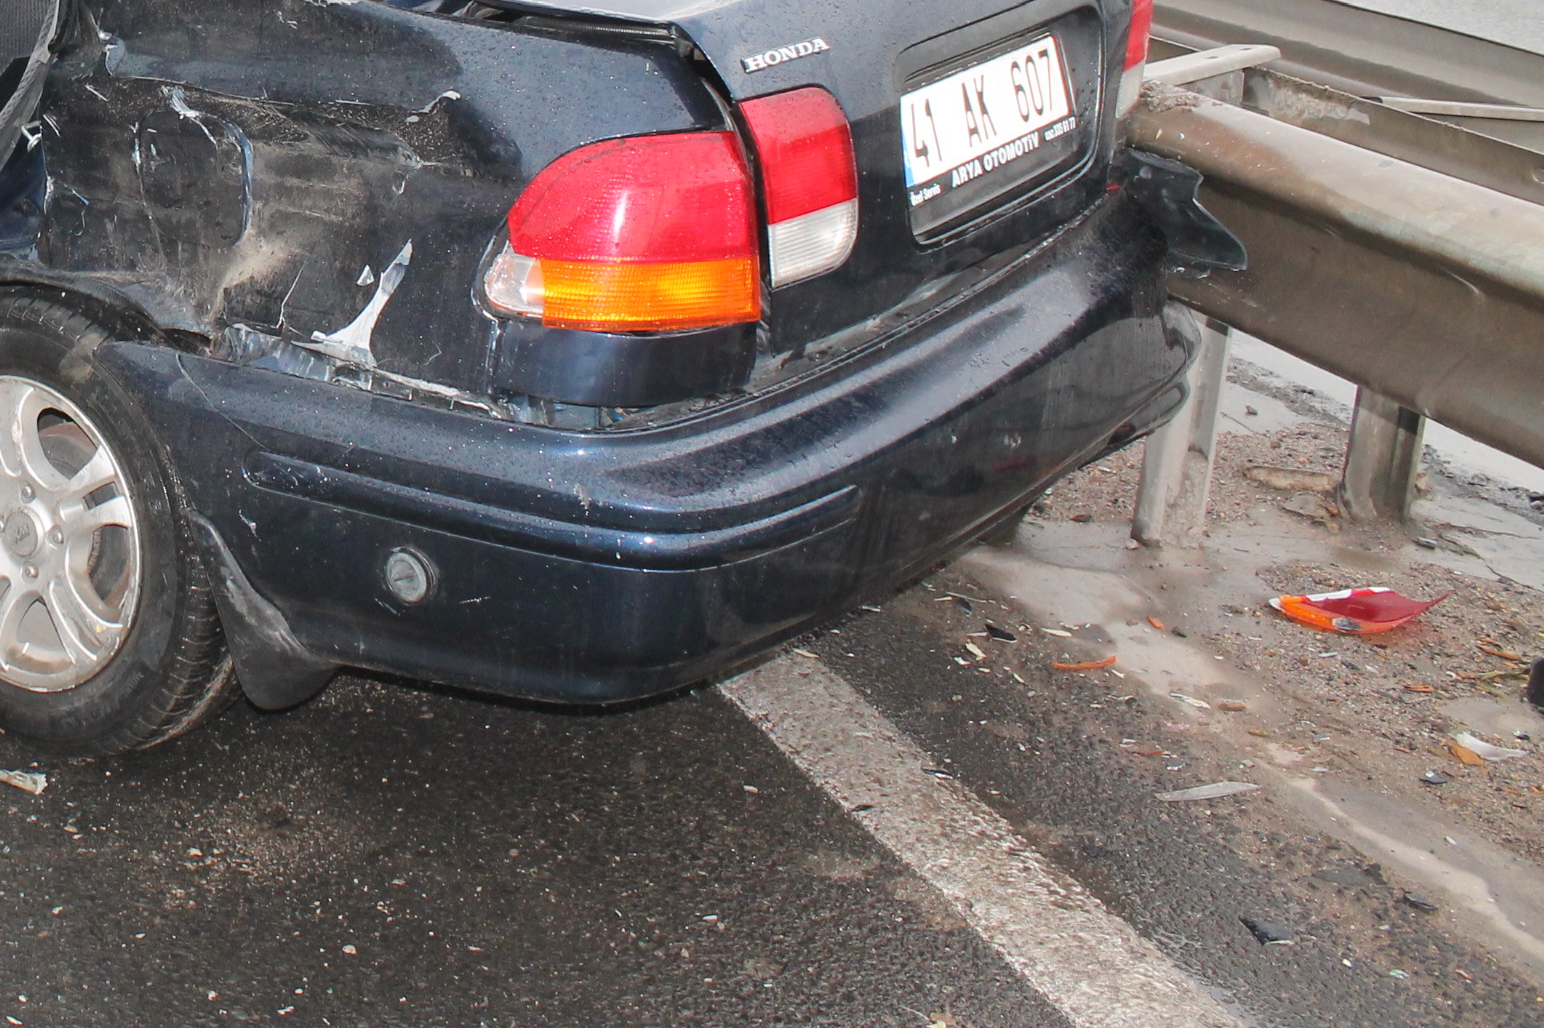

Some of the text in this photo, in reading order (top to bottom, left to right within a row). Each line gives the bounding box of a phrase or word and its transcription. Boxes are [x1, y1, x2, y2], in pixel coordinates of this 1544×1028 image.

[744, 37, 831, 73] HONDA
[911, 48, 1053, 168] 41 AK 607
[951, 159, 983, 188] ARYA
